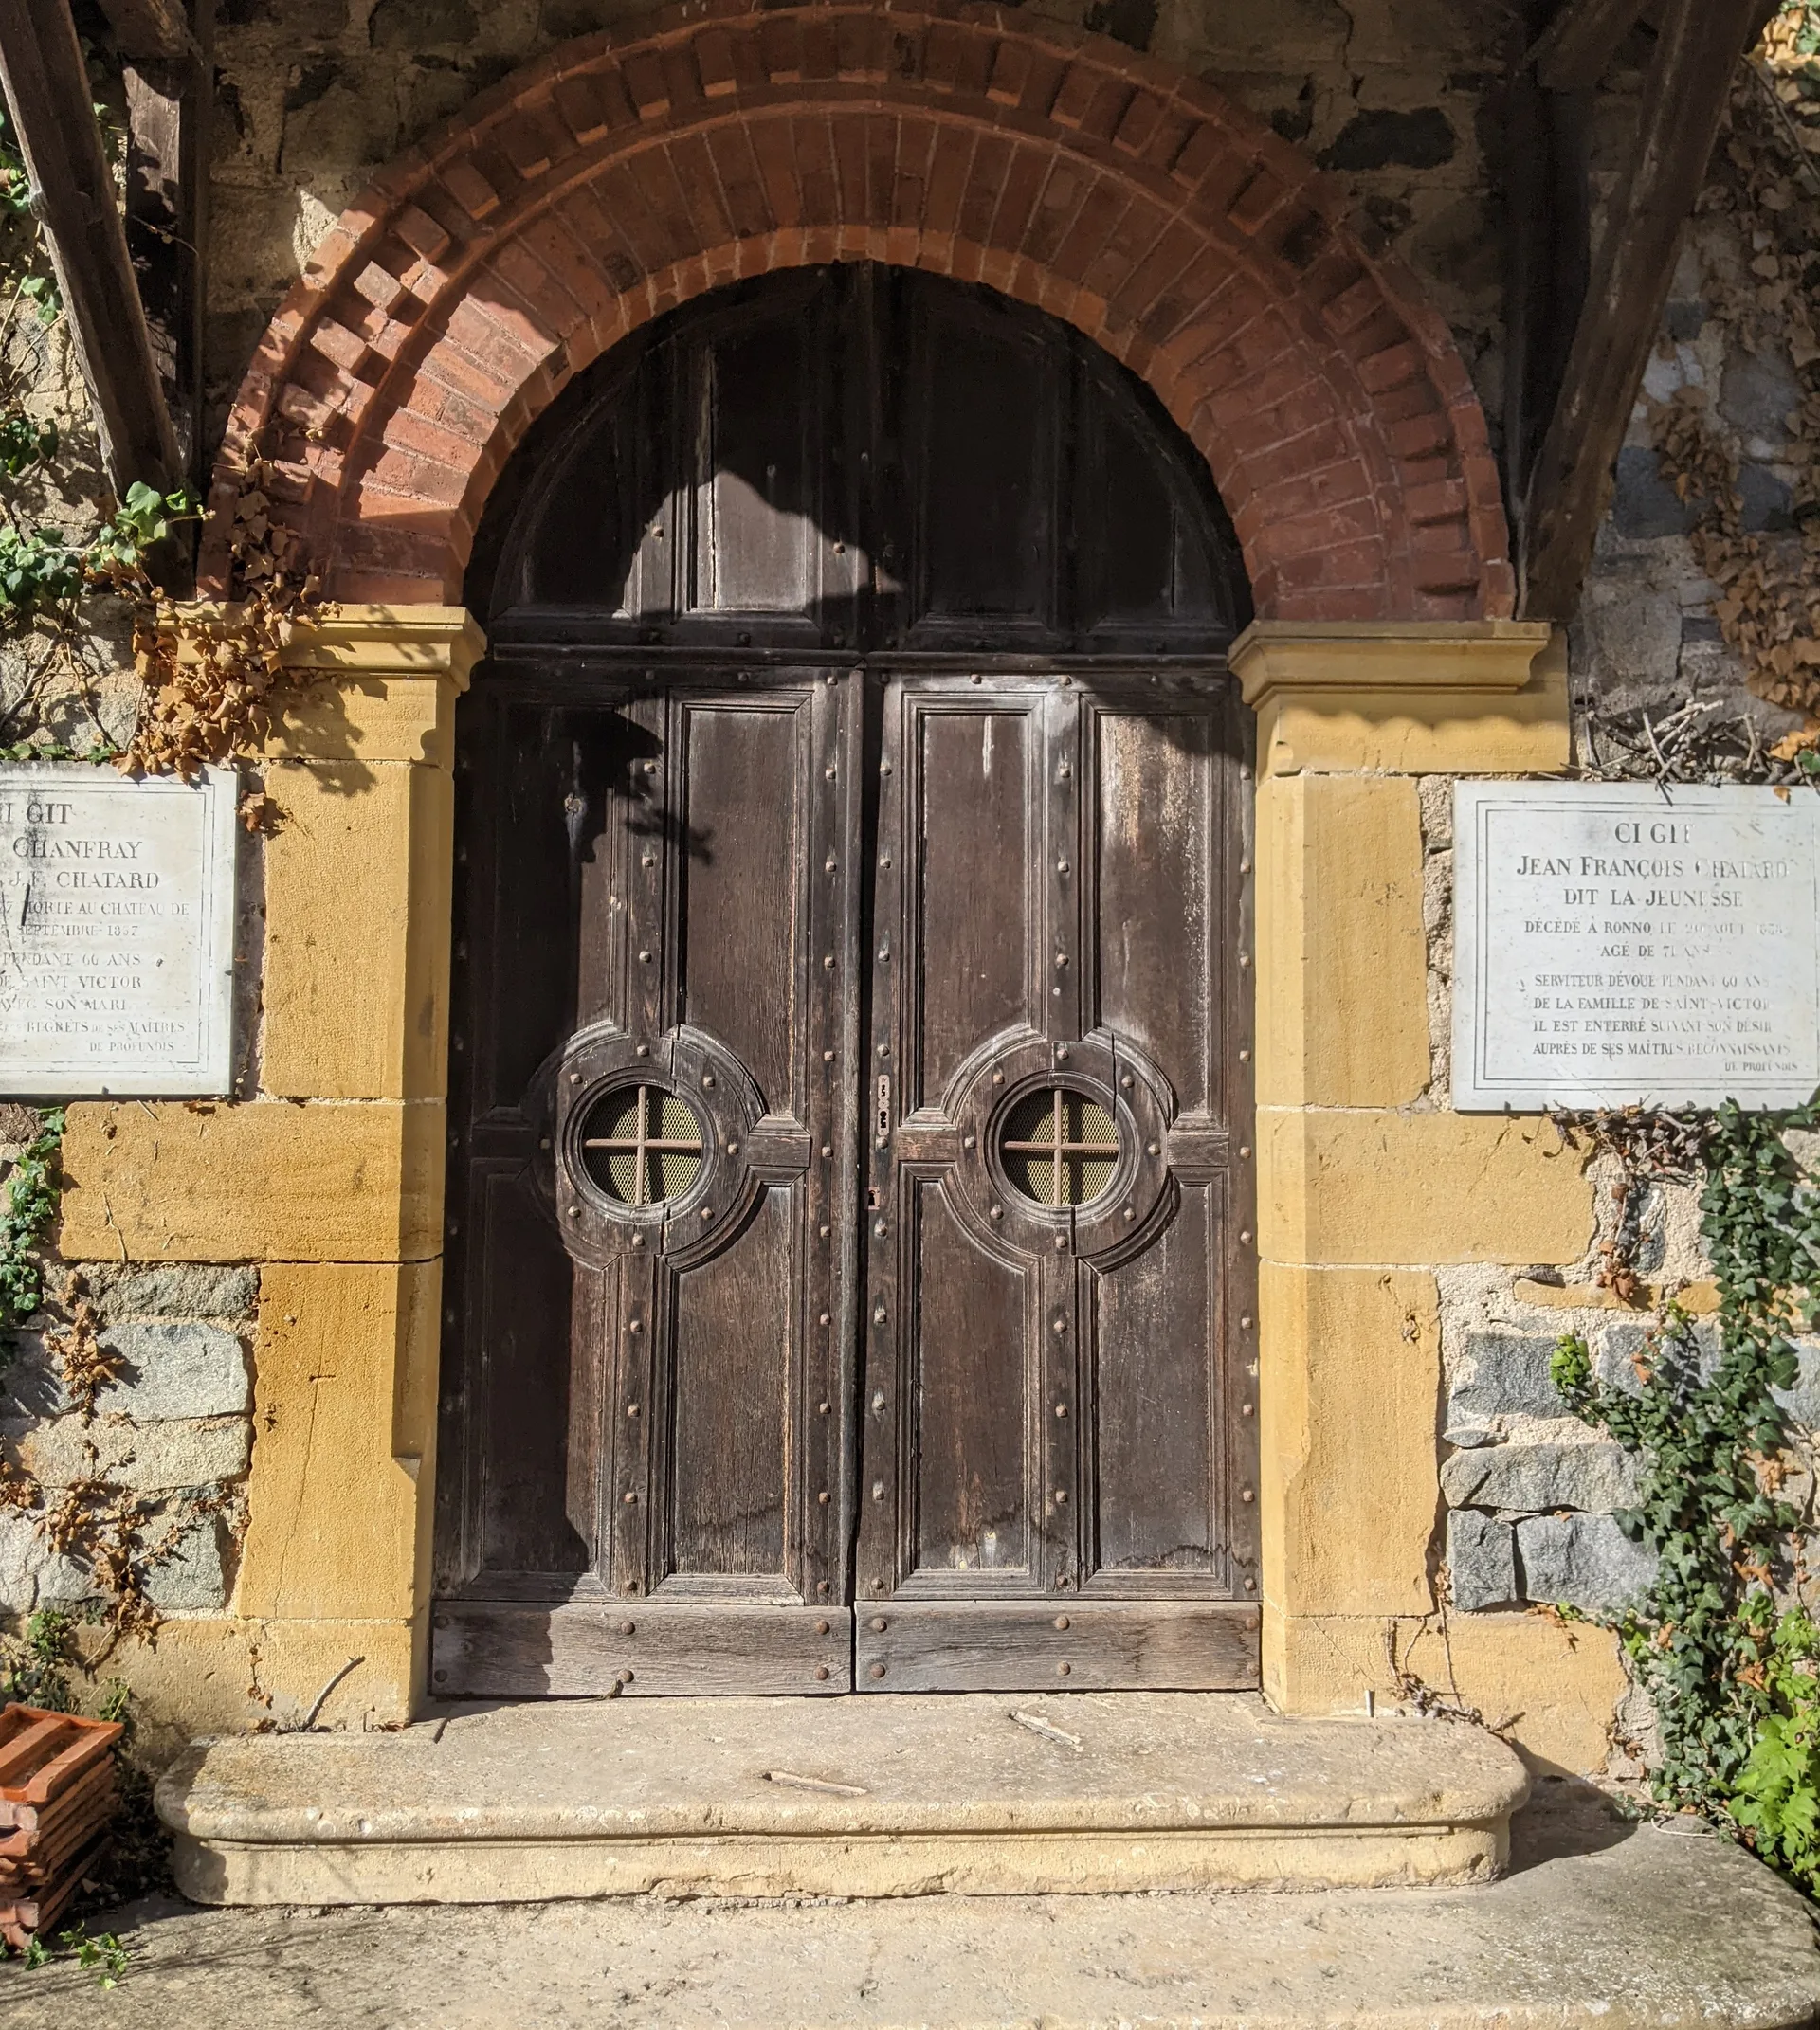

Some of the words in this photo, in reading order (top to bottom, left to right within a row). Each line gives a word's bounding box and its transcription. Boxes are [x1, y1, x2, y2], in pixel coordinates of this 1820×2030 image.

[27, 802, 73, 825] GIT
[1614, 822, 1642, 844] CI
[12, 837, 144, 859] CHANFRAY
[1516, 855, 1573, 876] JEAN
[1579, 856, 1684, 880] FRANÇOIS
[56, 871, 160, 889] CHATARD
[1562, 888, 1599, 905] DIT
[1610, 889, 1636, 906] LA
[1645, 889, 1744, 907] JEUNESSE
[78, 901, 97, 915] AU
[171, 902, 191, 916] DE
[1603, 920, 1652, 934] RONNO
[1638, 945, 1655, 958] DE
[106, 952, 141, 967] ANS
[78, 974, 142, 989] VICTOR
[1534, 974, 1604, 987] SERVITEUR
[46, 997, 77, 1011] SON
[1533, 997, 1551, 1009] DE
[1556, 997, 1574, 1009] LA
[1578, 997, 1636, 1010] FAMILLE
[1641, 997, 1660, 1010] DE
[1552, 1020, 1578, 1032] EST
[1584, 1016, 1647, 1032] ENTERRÉ
[89, 1042, 103, 1052] DE
[1582, 1042, 1597, 1055] DE
[1601, 1042, 1624, 1056] SES
